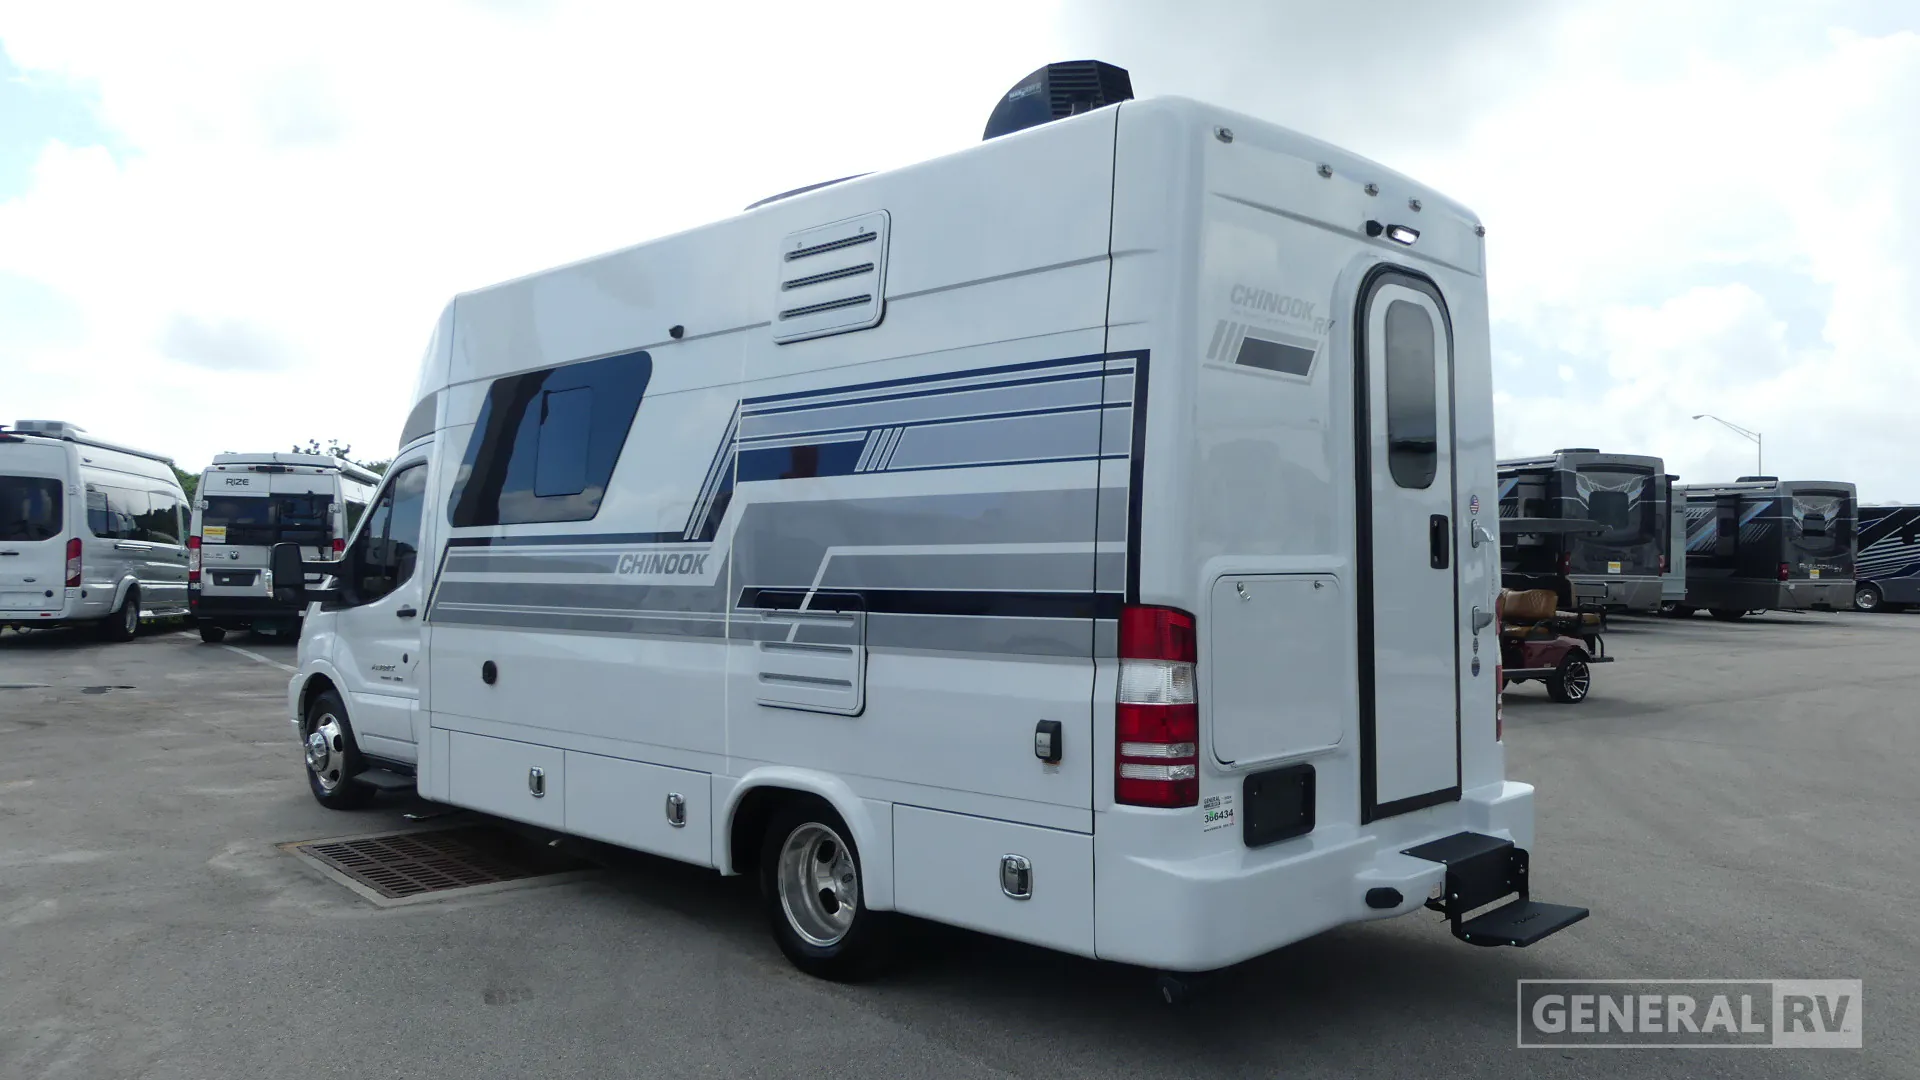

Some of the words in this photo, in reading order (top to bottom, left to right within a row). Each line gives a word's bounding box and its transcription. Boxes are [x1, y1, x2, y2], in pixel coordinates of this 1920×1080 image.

[1230, 283, 1316, 321] CHINOOK
[225, 478, 249, 486] RIZE
[618, 553, 710, 575] CHINOOK
[1204, 808, 1234, 824] 366434
